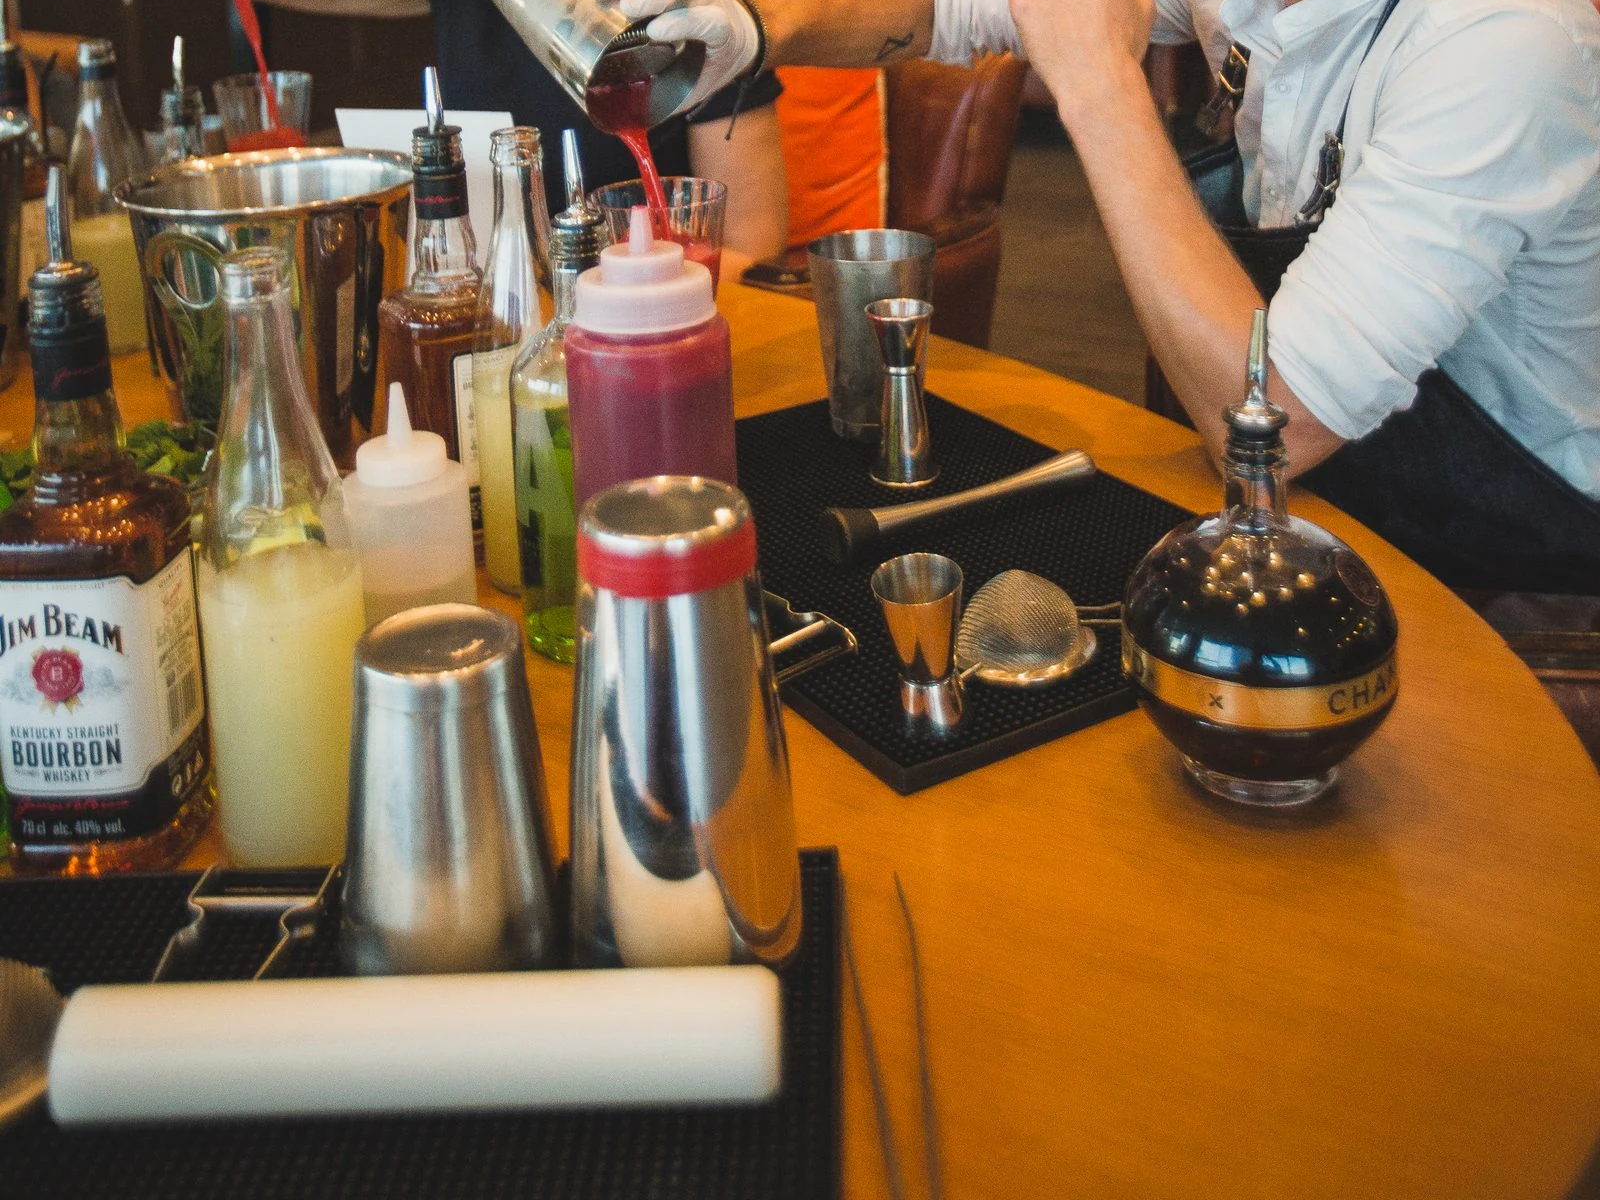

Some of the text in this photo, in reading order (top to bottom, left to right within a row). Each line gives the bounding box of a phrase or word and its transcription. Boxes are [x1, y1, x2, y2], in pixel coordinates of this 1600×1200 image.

[0, 613, 37, 658] JIM
[43, 603, 125, 656] BEAM
[10, 722, 120, 739] KENTUCKY STRAIGHT
[12, 737, 123, 767] BOURBON
[43, 769, 91, 783] WHISKEY
[53, 820, 73, 835] alc.
[75, 819, 101, 834] 40%
[104, 817, 127, 834] vol.
